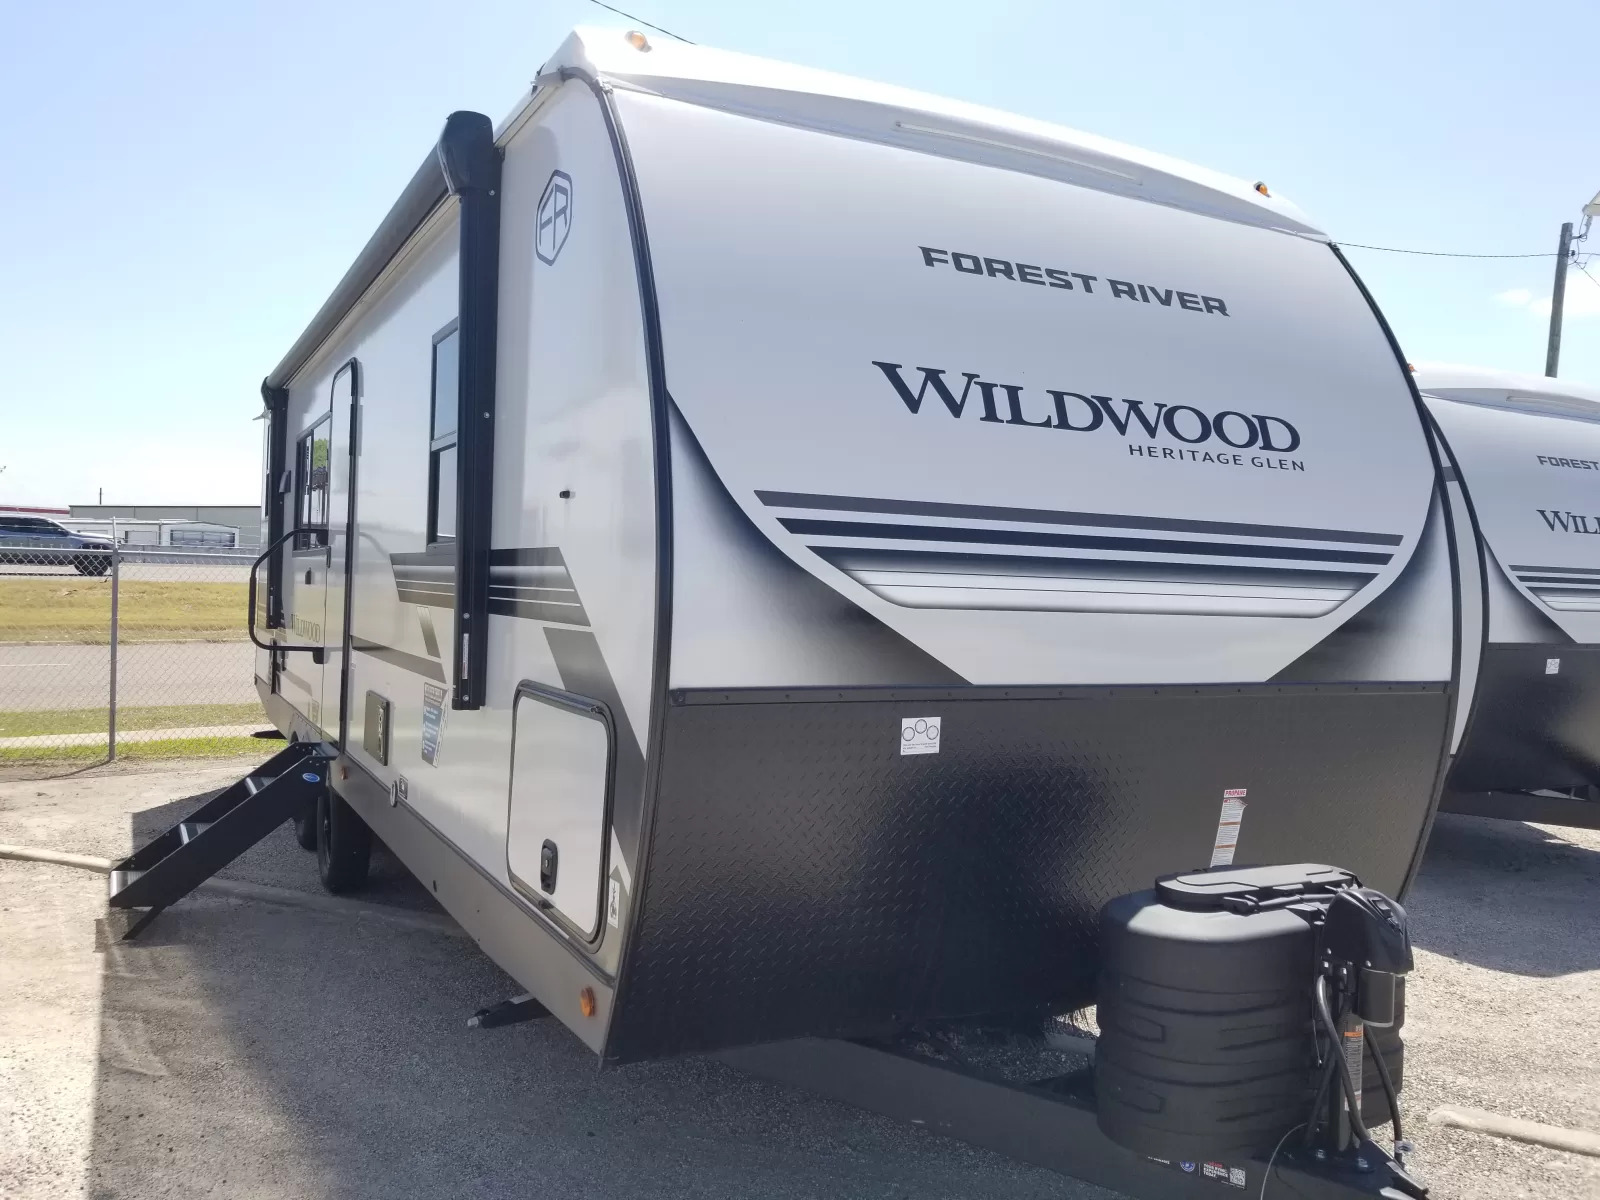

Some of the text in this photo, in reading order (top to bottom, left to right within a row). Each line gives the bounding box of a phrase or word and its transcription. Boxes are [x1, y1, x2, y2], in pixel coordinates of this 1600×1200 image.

[918, 245, 1231, 317] FOREST RIVER
[871, 360, 1301, 453] WILDWOOD
[1128, 444, 1306, 472] HERITAGE GLEN
[1536, 455, 1600, 471] FOREST
[1225, 789, 1246, 797] PROPANE
